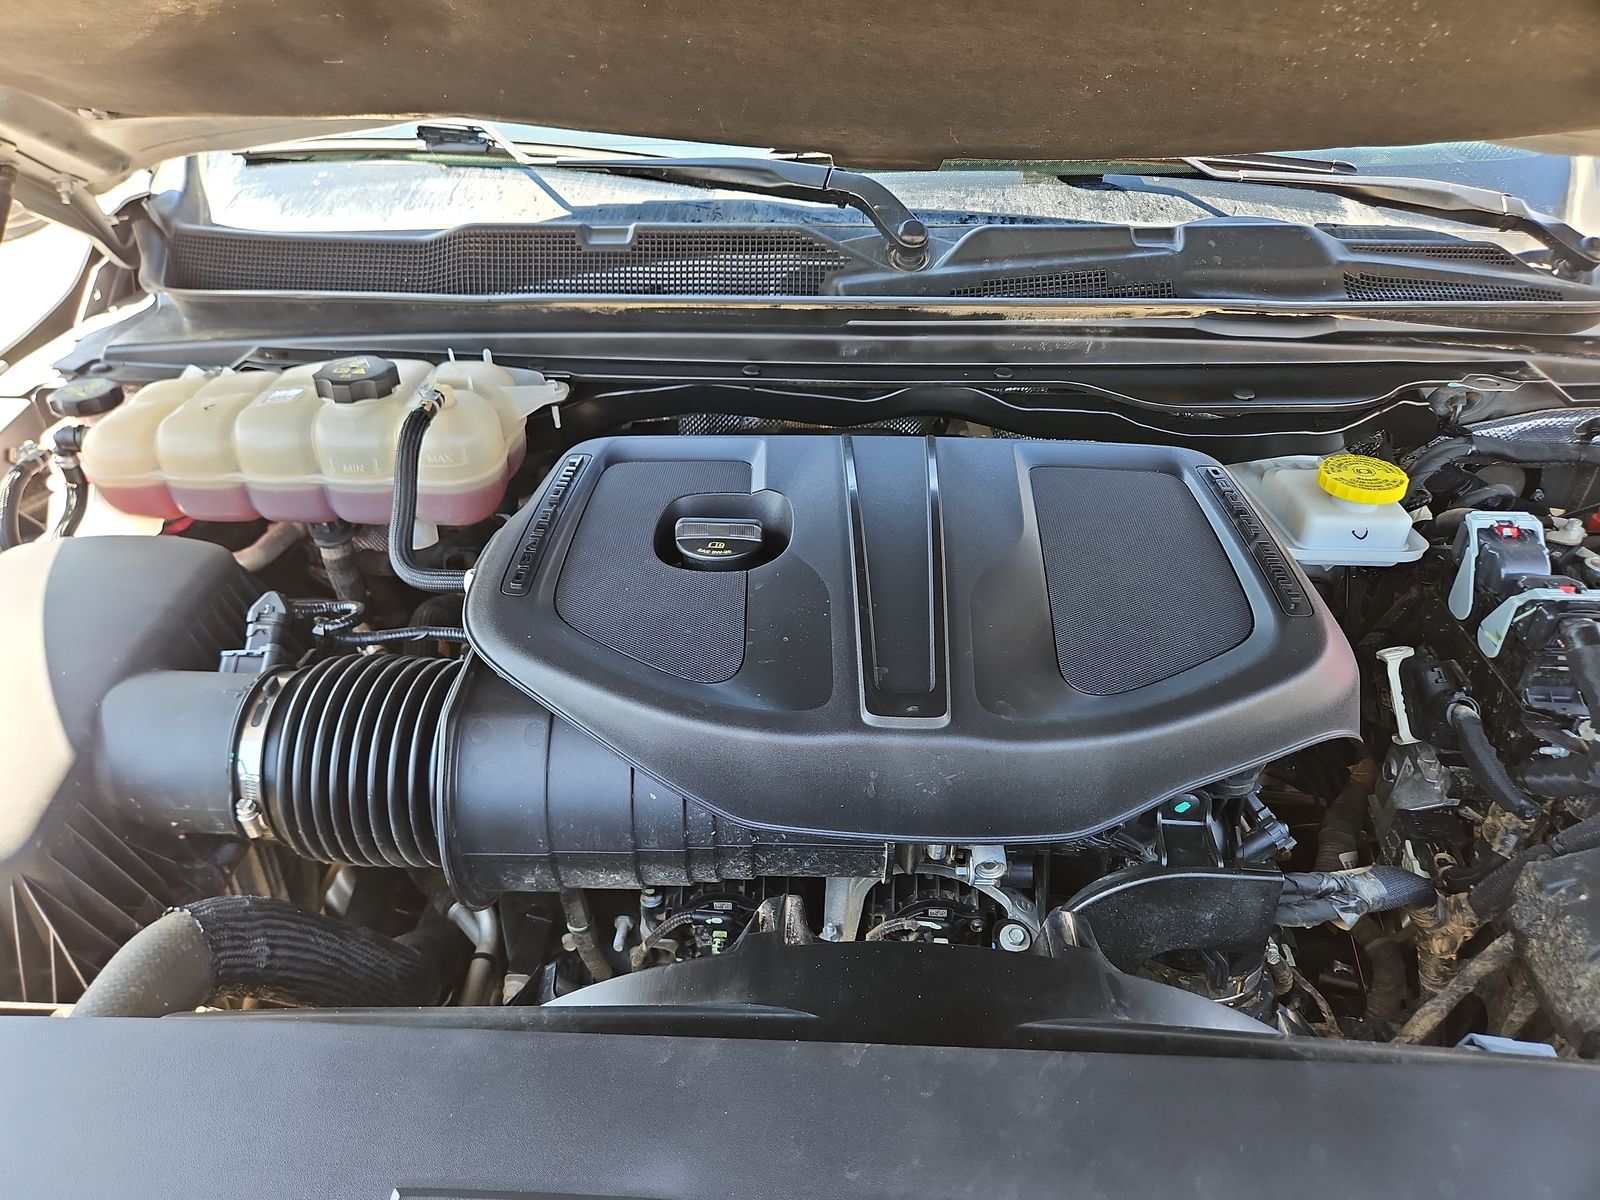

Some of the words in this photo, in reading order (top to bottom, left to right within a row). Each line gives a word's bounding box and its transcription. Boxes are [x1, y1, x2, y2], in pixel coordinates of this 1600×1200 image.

[343, 463, 365, 473] MIN
[427, 454, 454, 463] MAX
[1206, 467, 1261, 536] TURBO
[510, 505, 557, 589] TURBO
